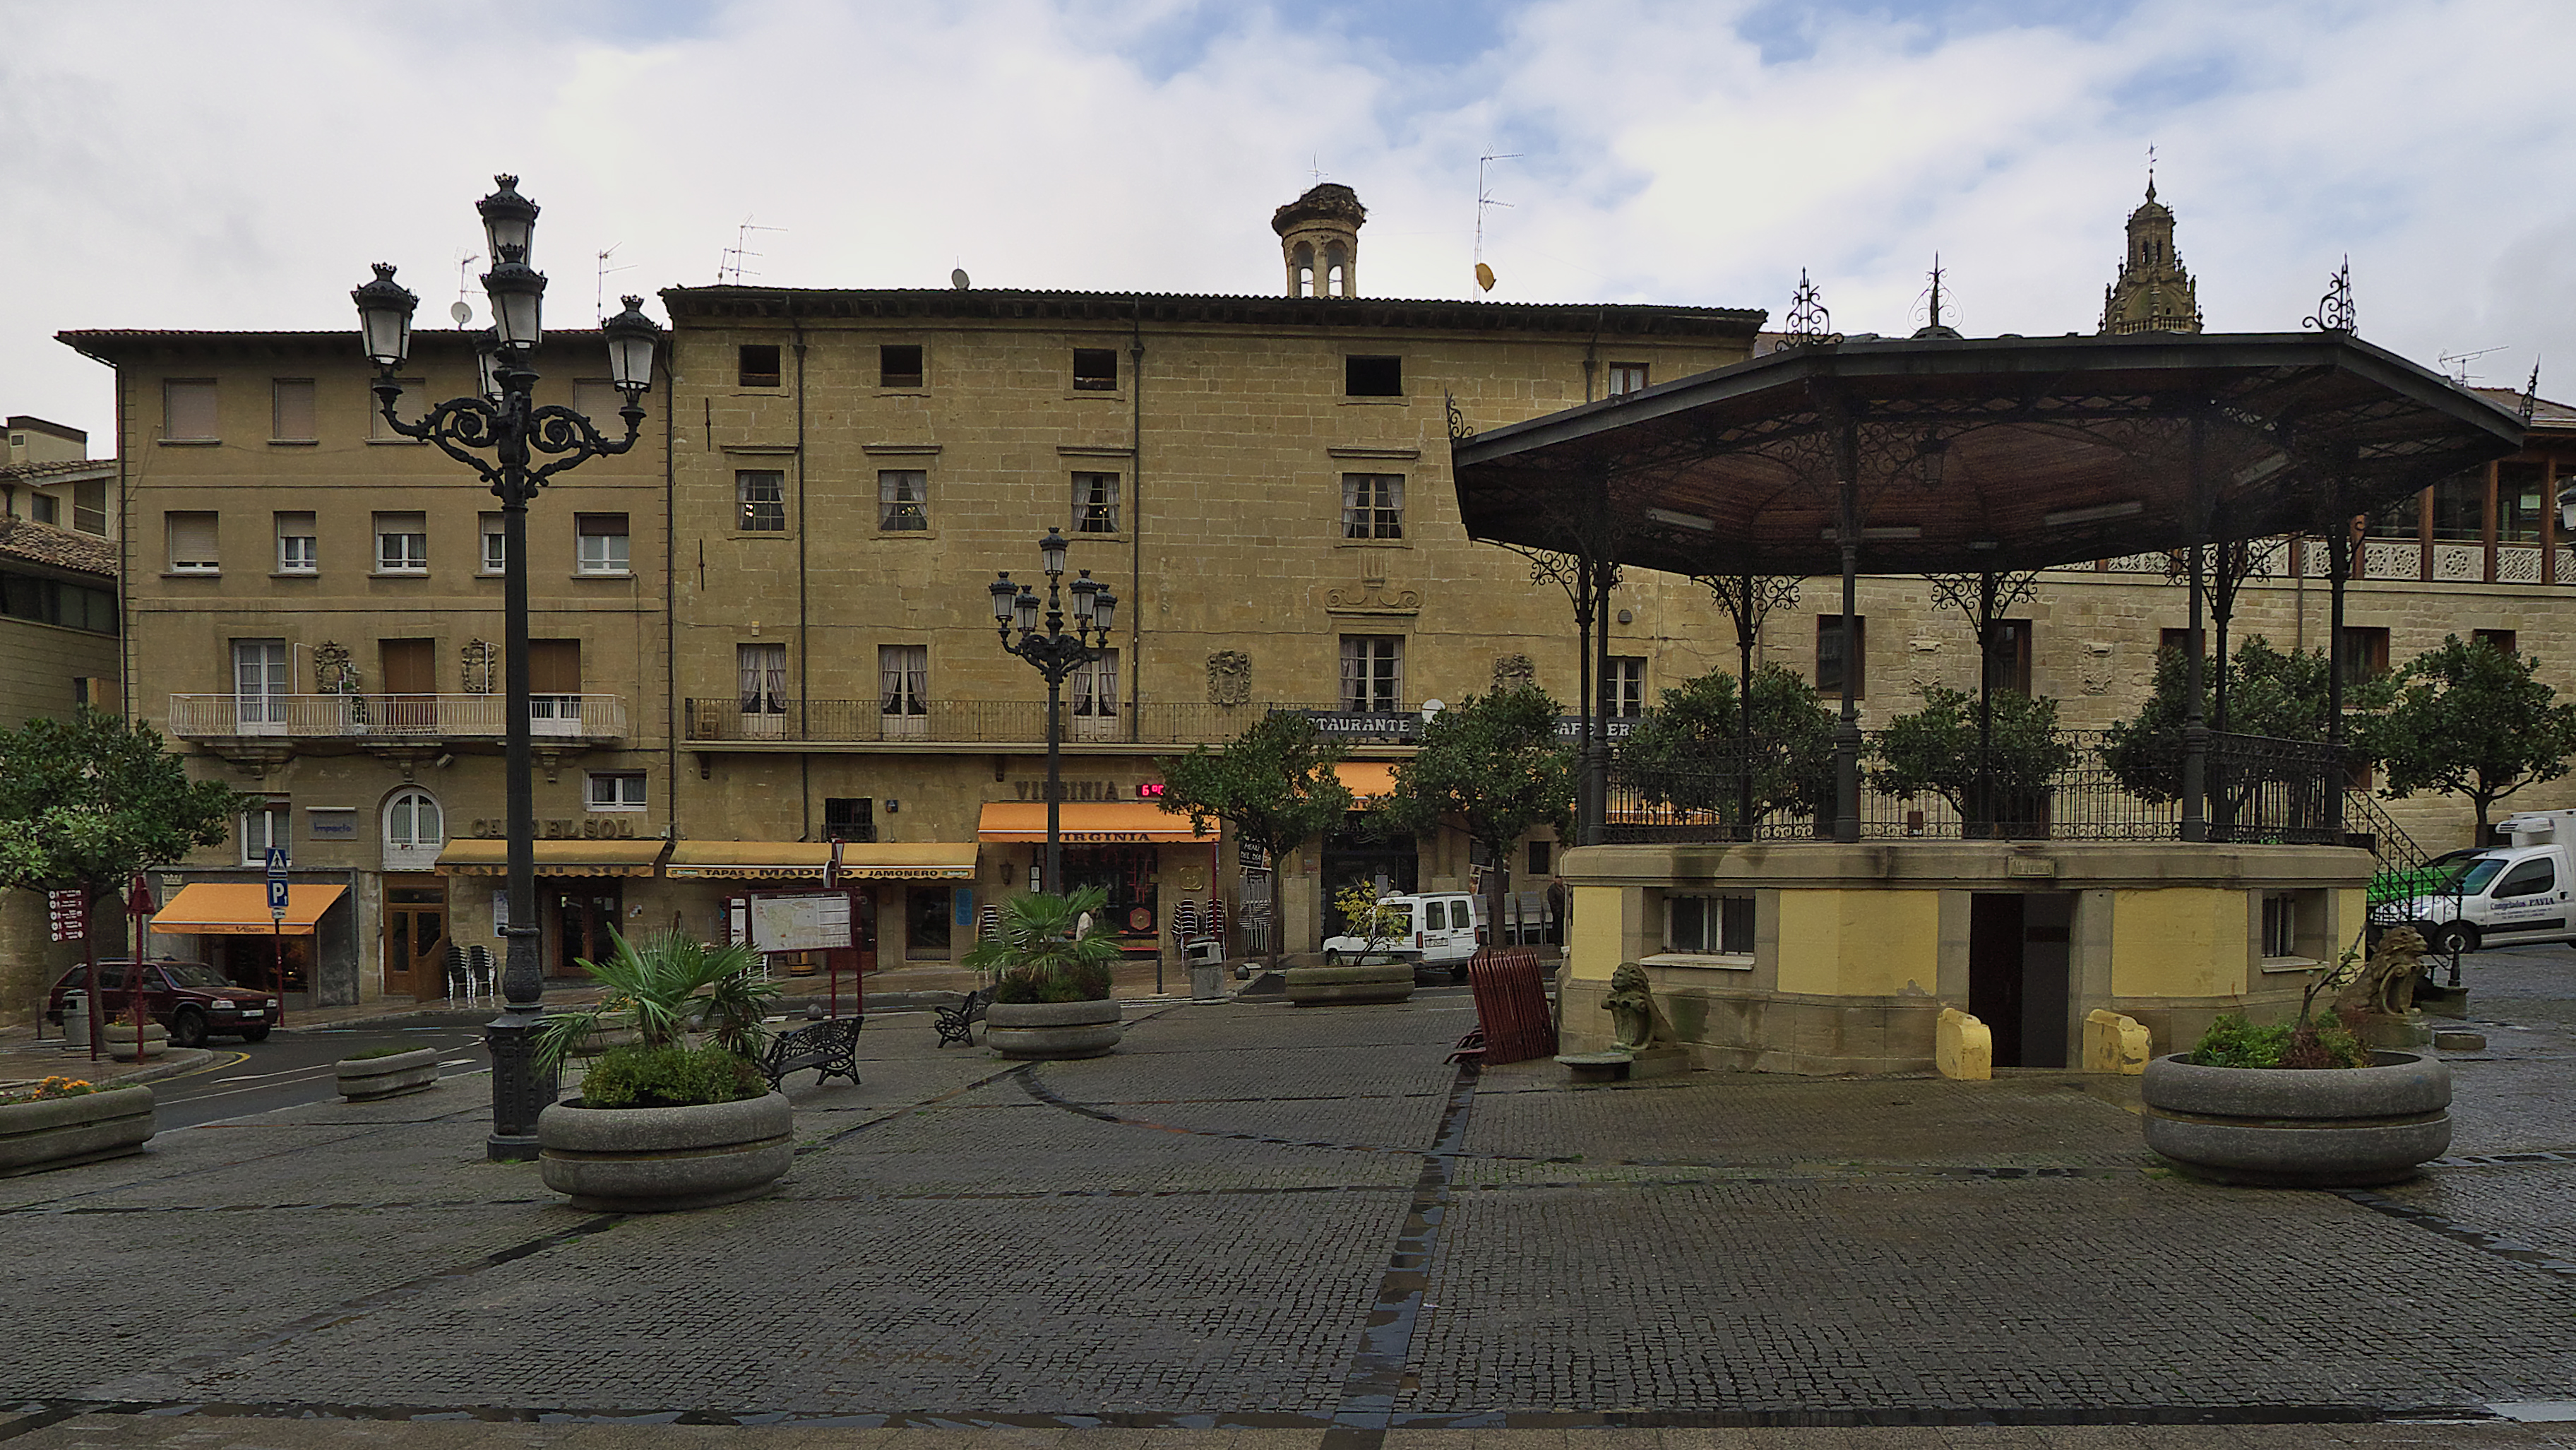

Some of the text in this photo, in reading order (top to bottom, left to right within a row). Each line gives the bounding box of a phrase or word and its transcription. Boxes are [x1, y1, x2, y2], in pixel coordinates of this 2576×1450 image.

[1141, 784, 1150, 797] 6
[544, 819, 580, 838] EL
[583, 819, 633, 839] SOL
[1059, 833, 1151, 841] IRGINIA
[272, 882, 285, 903] P
